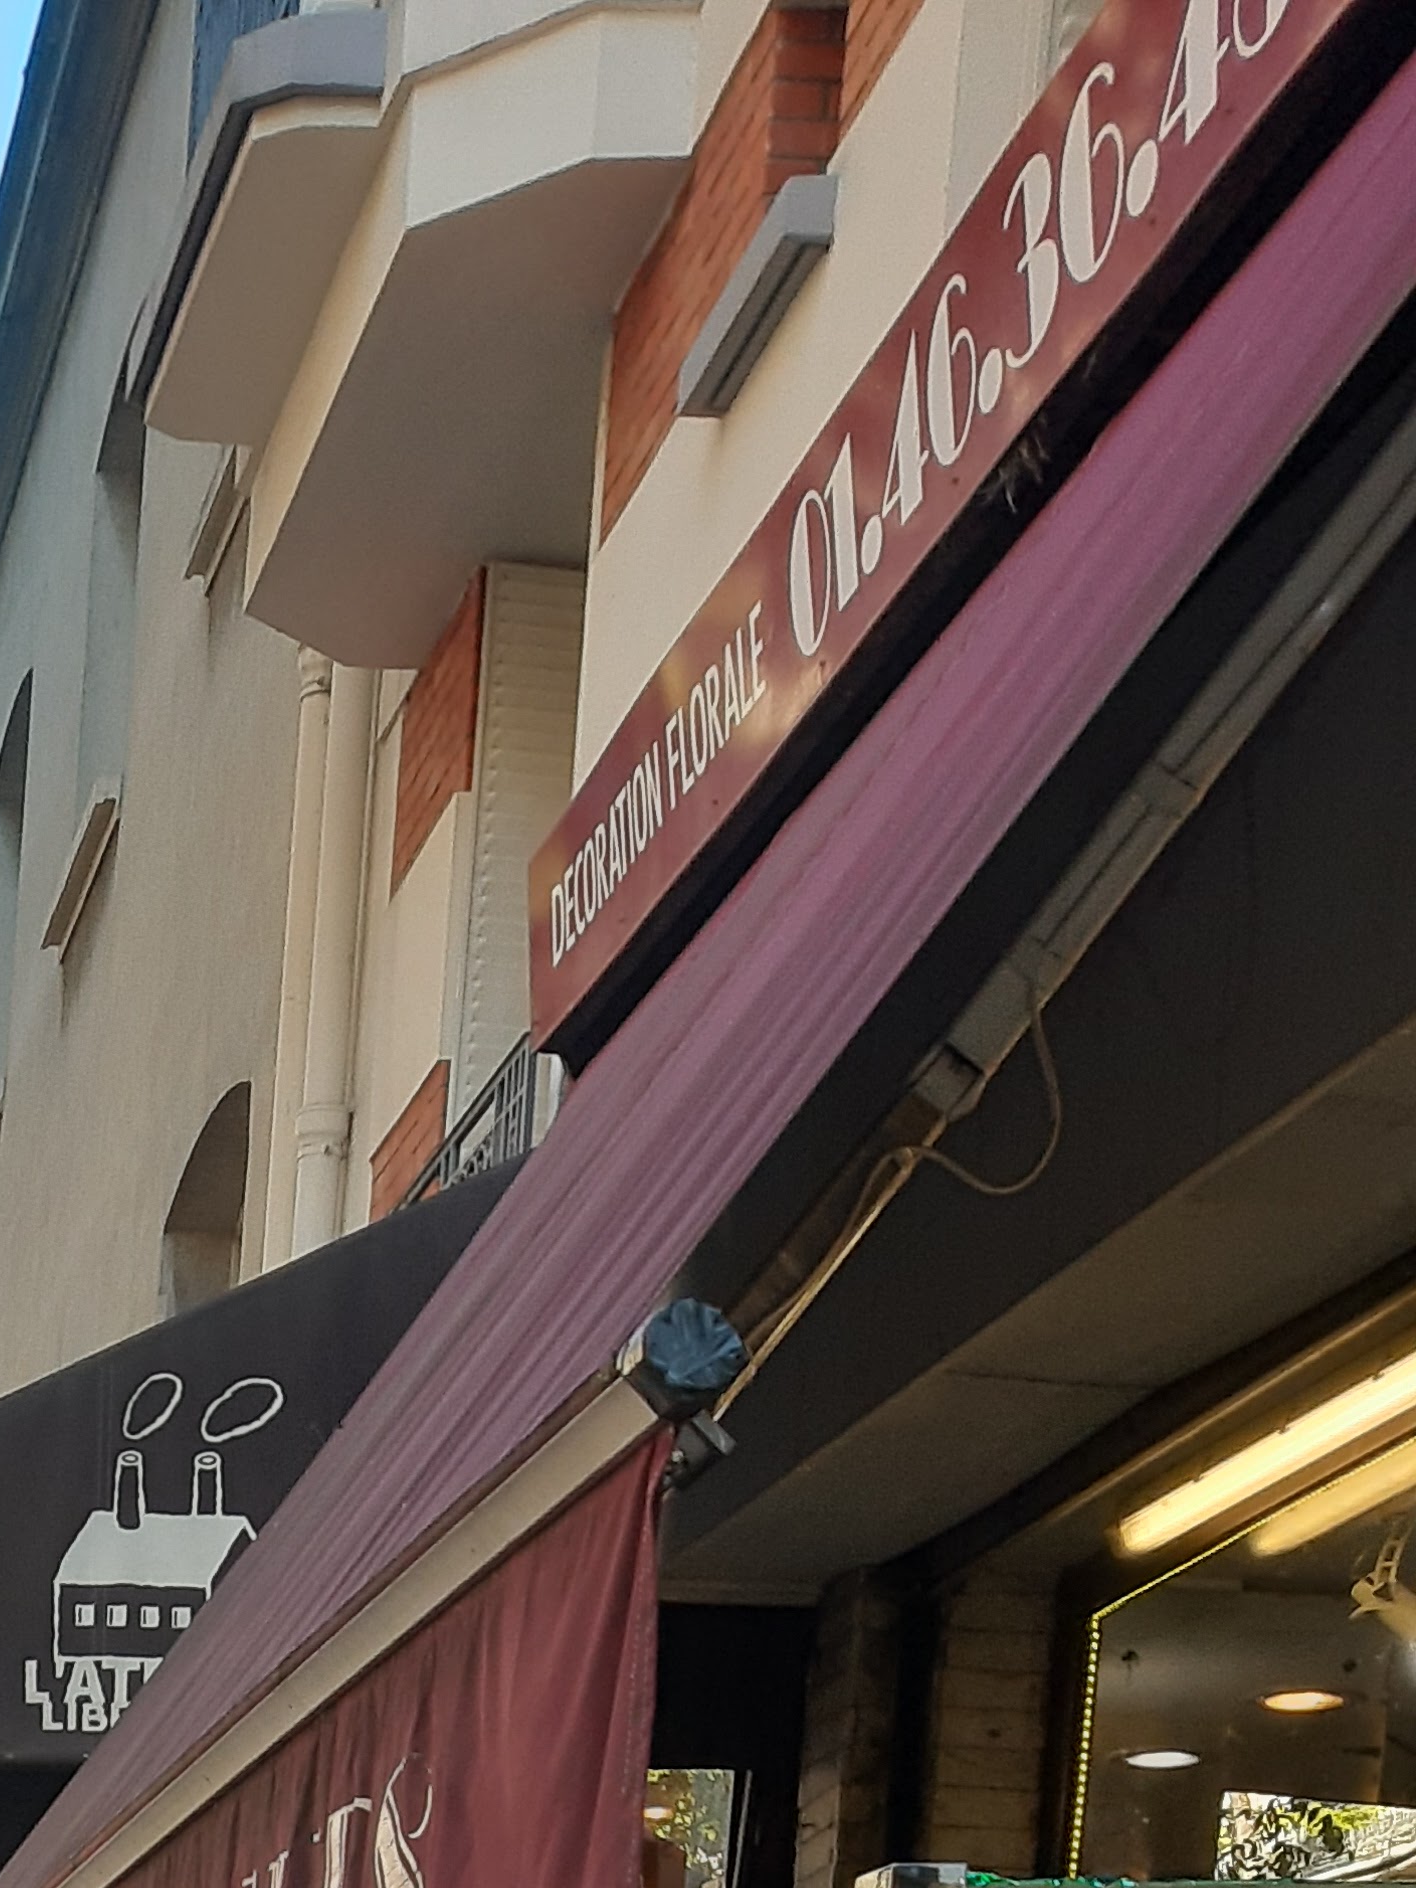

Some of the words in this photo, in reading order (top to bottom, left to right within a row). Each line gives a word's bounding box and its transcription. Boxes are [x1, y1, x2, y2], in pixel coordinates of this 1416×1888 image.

[551, 740, 664, 968] DECORATION
[665, 599, 767, 812] FLORALE
[788, 0, 1289, 658] 01.46.36.4
[41, 1699, 121, 1731] LIB
